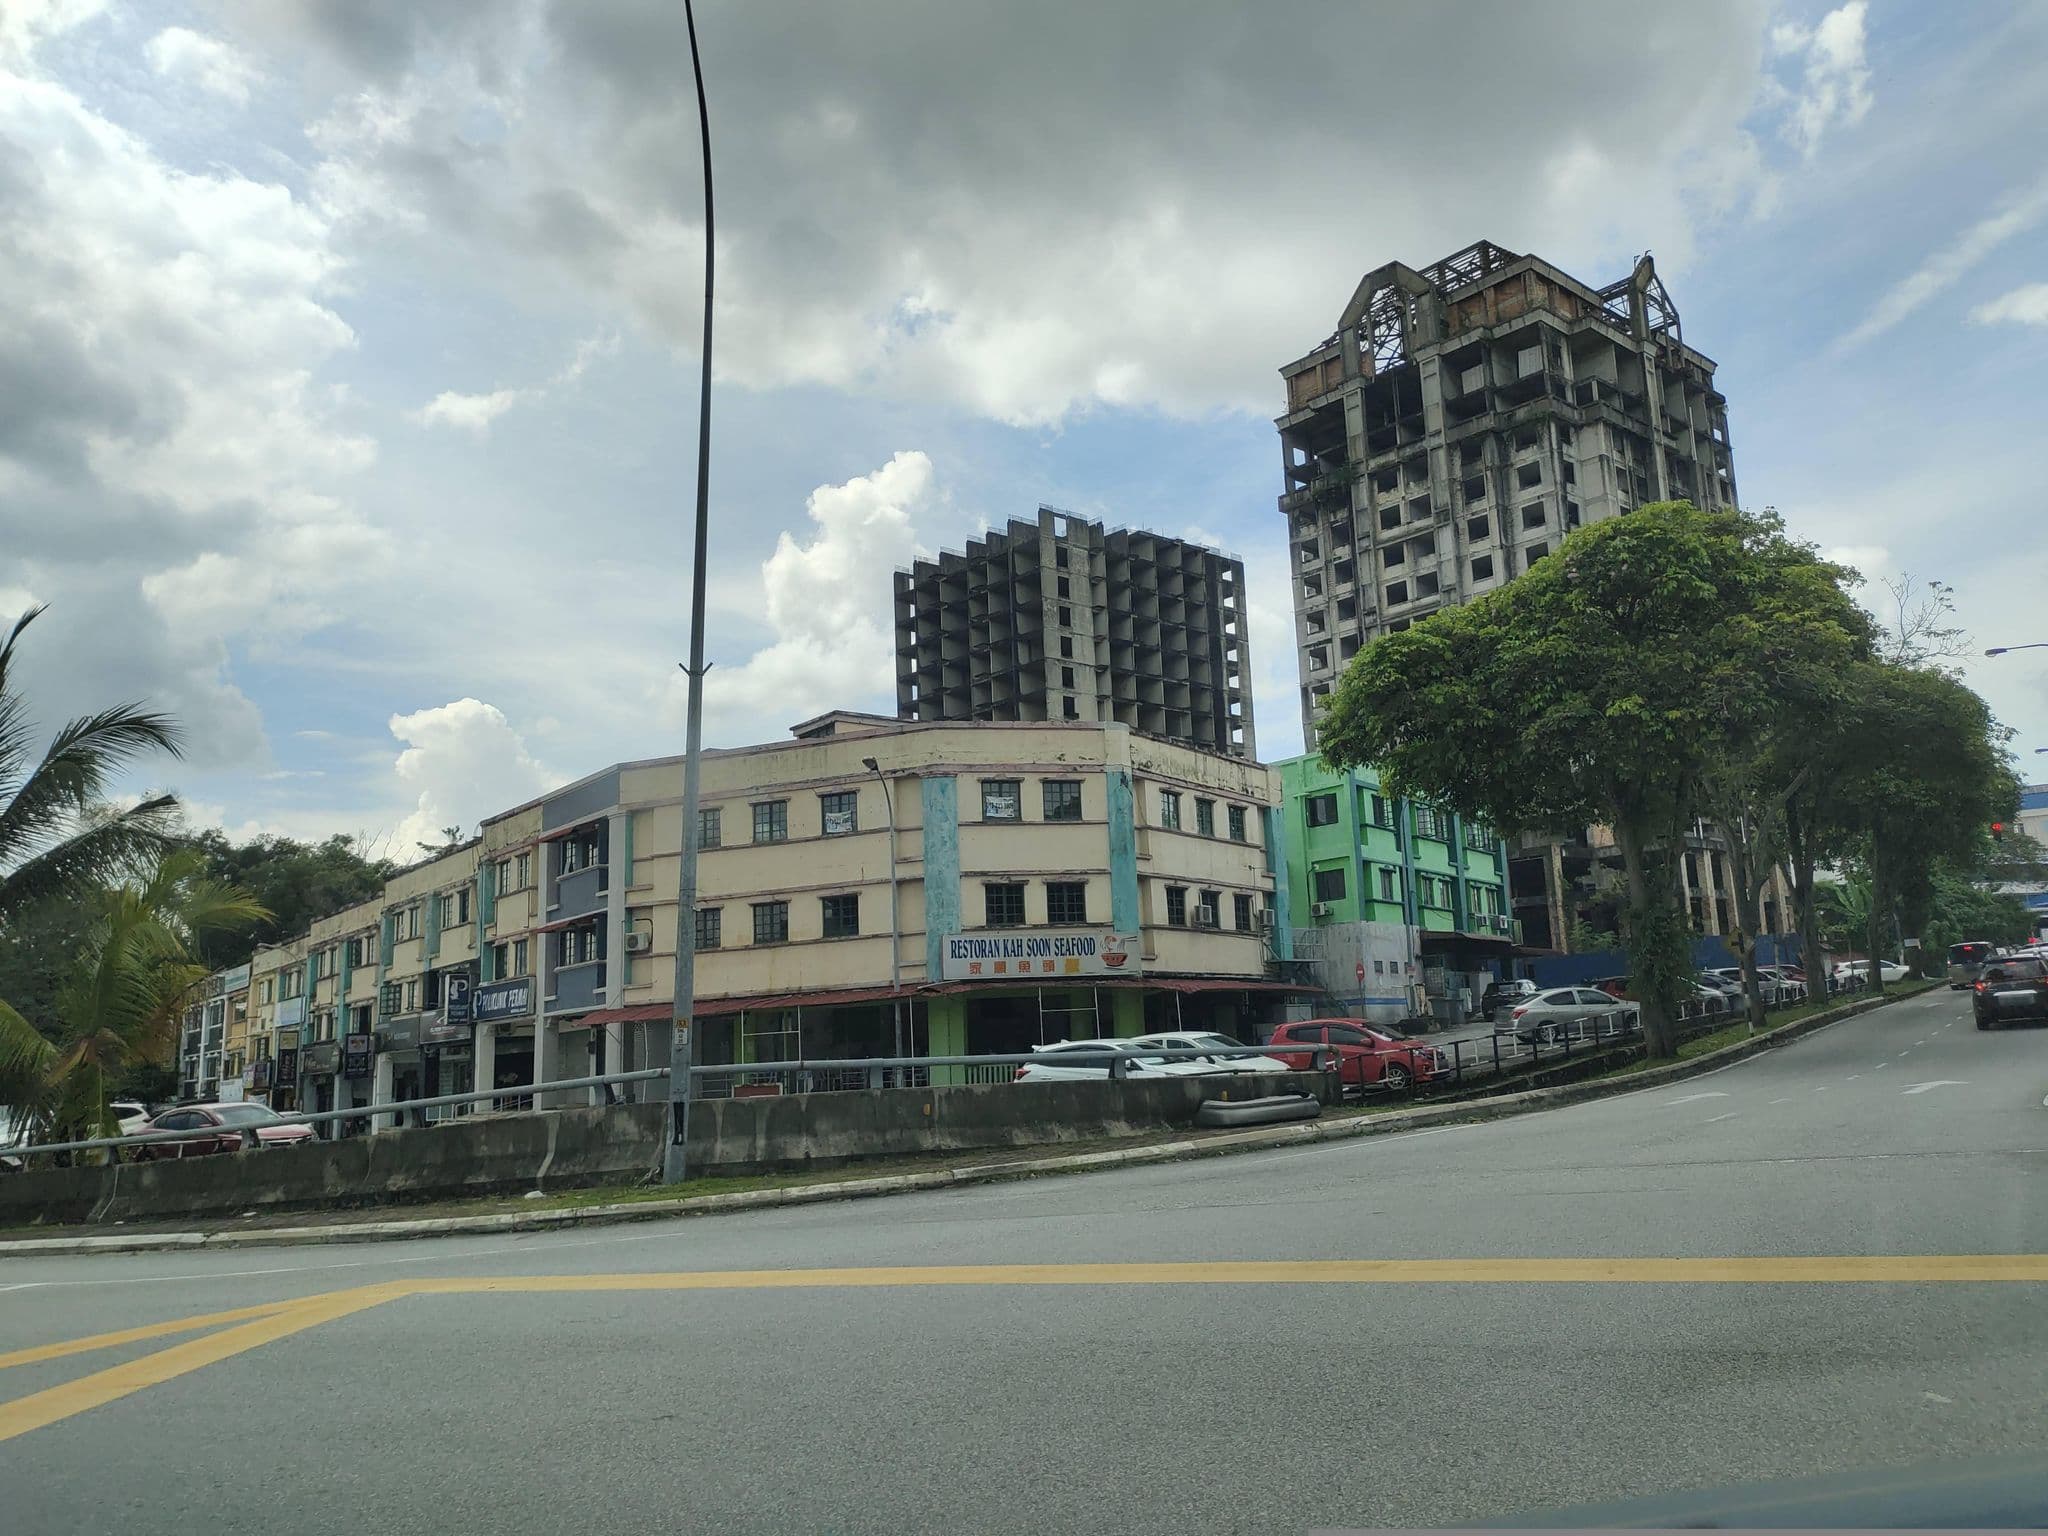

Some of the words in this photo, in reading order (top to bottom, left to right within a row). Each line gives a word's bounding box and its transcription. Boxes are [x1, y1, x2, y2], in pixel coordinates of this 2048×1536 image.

[950, 938, 1000, 959] RESTORAN
[1003, 938, 1024, 958] KAH
[1026, 938, 1051, 957] SOON
[1054, 936, 1096, 957] SEAFOOD
